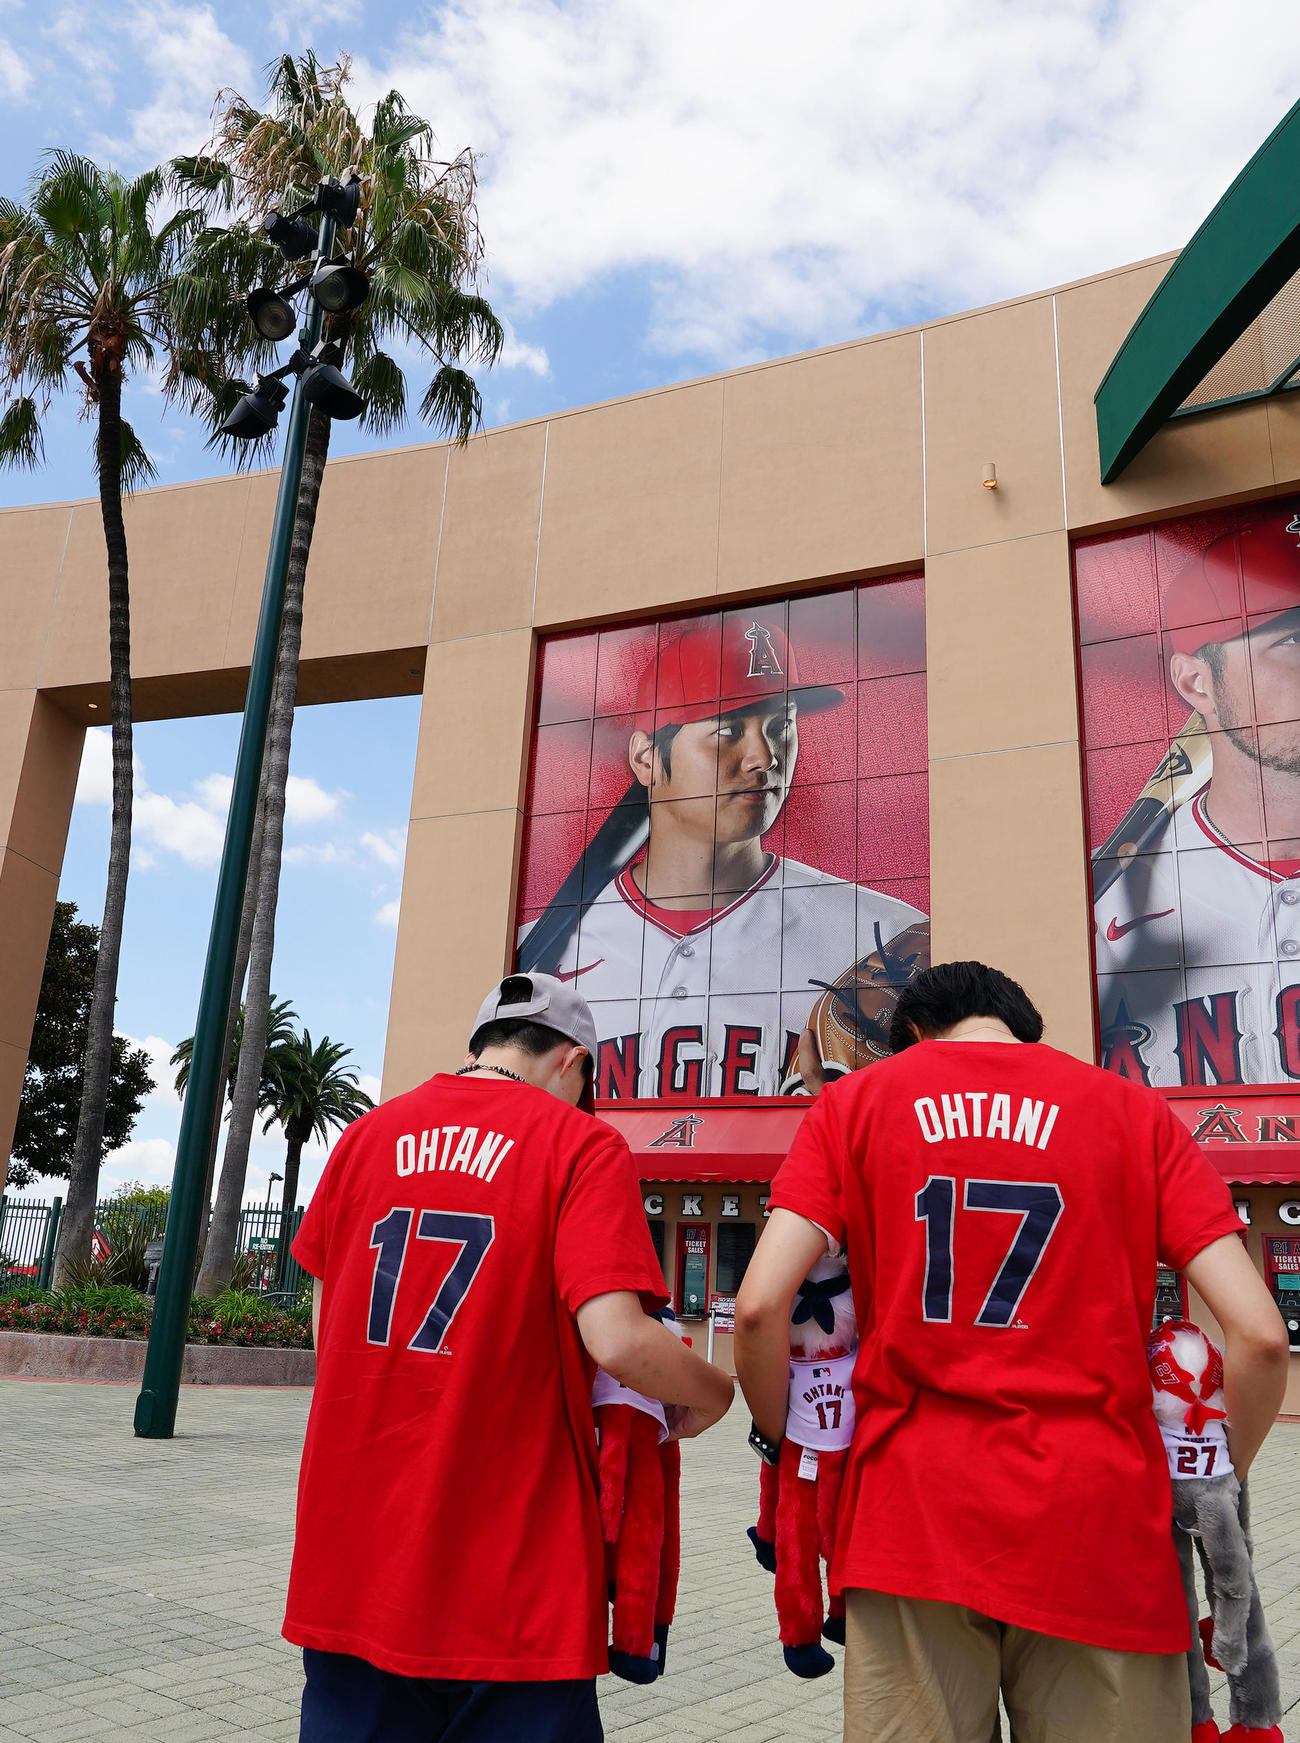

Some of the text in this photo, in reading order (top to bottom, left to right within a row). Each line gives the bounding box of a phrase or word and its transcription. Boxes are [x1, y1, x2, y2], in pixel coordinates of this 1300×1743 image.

[745, 621, 784, 677] A
[648, 1113, 705, 1148] A
[913, 1092, 1060, 1151] OHTANI
[396, 1126, 515, 1183] OHTANI
[914, 1174, 1066, 1328] 17
[1273, 1241, 1288, 1255] 21
[366, 1206, 496, 1354] 17
[1278, 1263, 1299, 1271] SALES
[1155, 1362, 1180, 1385] 27
[802, 1383, 846, 1404] OHTANI
[815, 1399, 842, 1430] 17
[1177, 1446, 1217, 1476] 27
